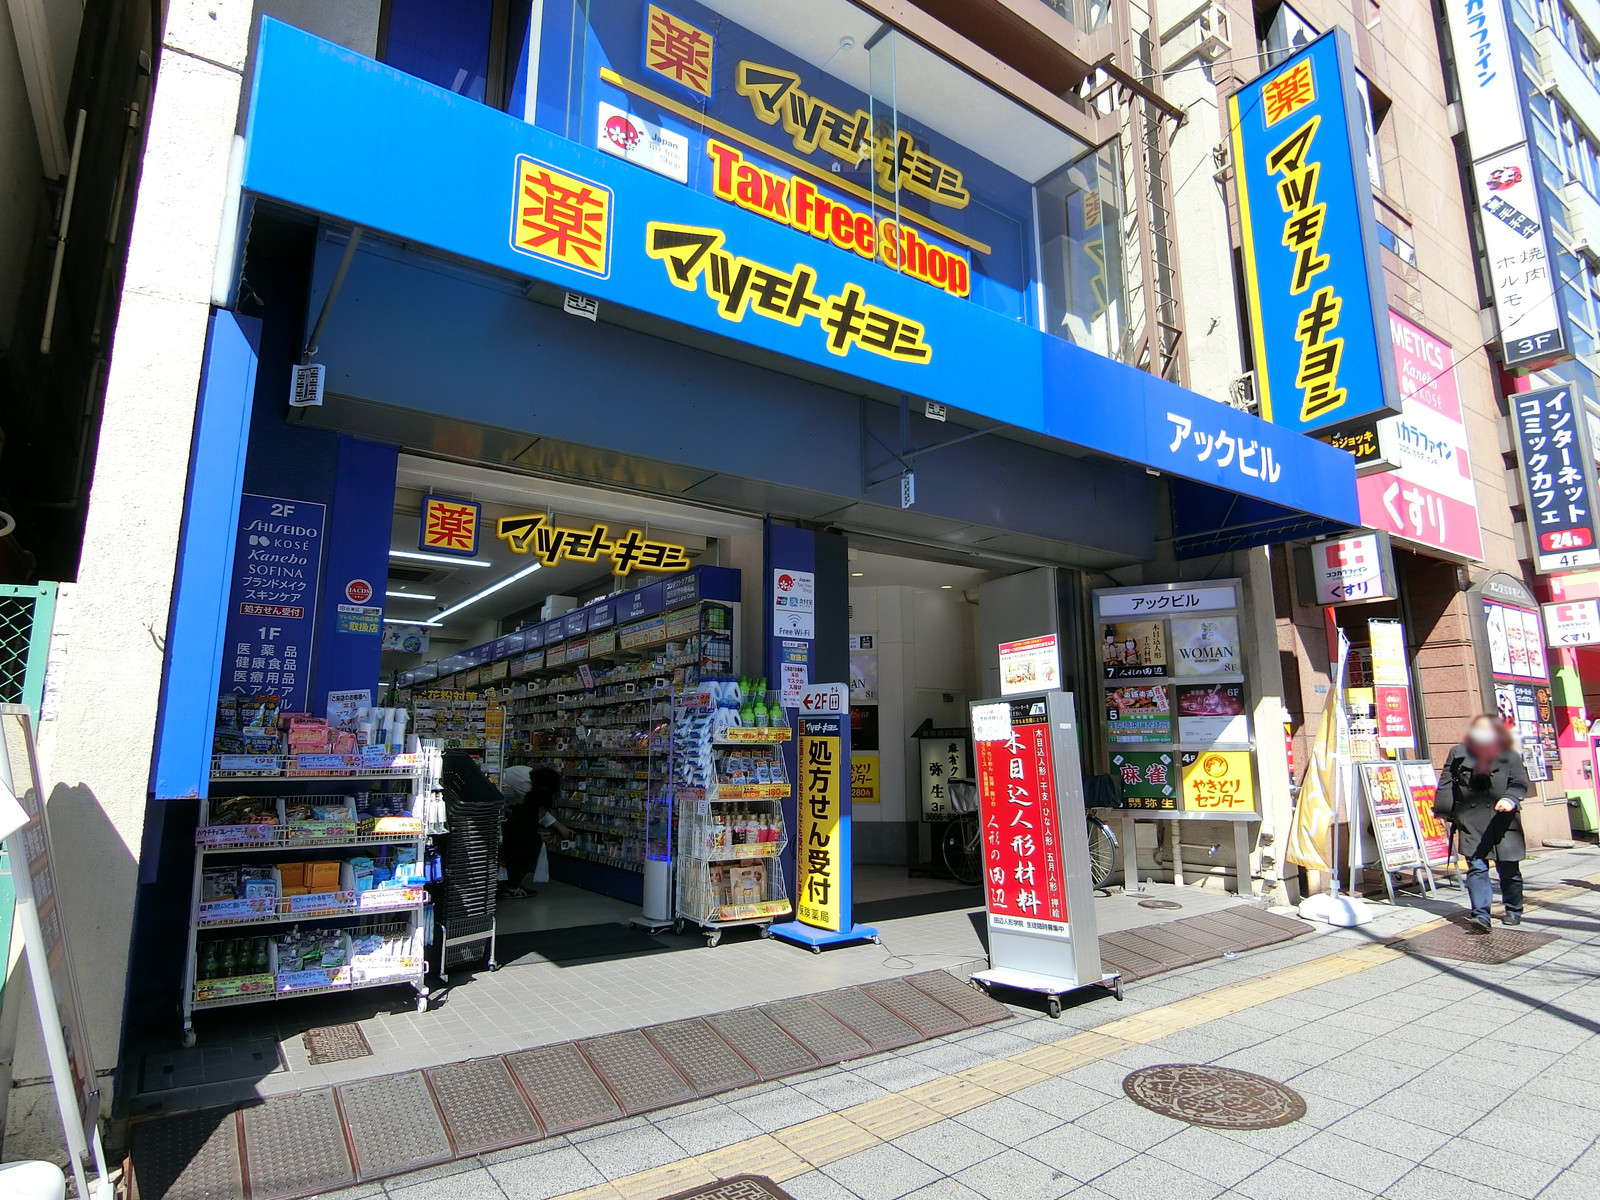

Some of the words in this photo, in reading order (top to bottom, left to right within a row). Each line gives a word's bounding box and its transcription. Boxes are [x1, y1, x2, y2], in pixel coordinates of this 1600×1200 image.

[650, 12, 711, 93] 薬
[1265, 62, 1312, 125] 薬
[651, 132, 679, 150] Japan
[740, 64, 969, 206] マツモトキヨシ
[522, 169, 602, 269] 薬
[710, 141, 789, 221] Tax
[793, 178, 876, 256] Free
[880, 219, 969, 294] Shop
[1268, 117, 1346, 420] マツモトキヨシ
[1521, 247, 1547, 285] 焼肉
[649, 225, 929, 362] マツモトキヨシ
[1496, 256, 1526, 328] ホルモン
[1518, 334, 1551, 354] 3F
[1402, 357, 1438, 390] Kanebo
[1166, 411, 1281, 483] アックビル
[1396, 420, 1452, 460] カラファイン
[1519, 399, 1561, 525] コミックカフェ
[1545, 391, 1586, 523] インターネット
[270, 503, 296, 517] 2F
[1382, 481, 1446, 544] くすり
[243, 519, 318, 538] SHISEIDO
[427, 502, 475, 550] 薬
[274, 538, 310, 551] KOSÉ
[499, 515, 689, 573] マツモトキヨシ
[247, 549, 308, 566] Kanebo
[1559, 555, 1580, 568] 4F
[248, 563, 304, 578] SOFINA
[1326, 566, 1369, 579] ココカラファイン
[242, 576, 307, 592] ブランドメイク
[1330, 581, 1369, 599] くすり
[245, 589, 302, 603] スキンケア
[1131, 594, 1200, 611] アックビル
[244, 604, 301, 617] 処方せん受付
[258, 627, 282, 640] 1F
[348, 621, 379, 633] 取扱店
[779, 627, 794, 636] Free
[794, 628, 811, 637] Wi-Fi
[1560, 632, 1591, 643] くすり
[237, 642, 298, 658] 医薬品
[1179, 646, 1235, 660] WOMAN
[235, 656, 297, 671] 健康食品
[233, 670, 296, 685] 医療用品
[1106, 668, 1115, 678] 7
[232, 685, 294, 697] ヘアケア
[427, 689, 479, 701] 花粉対策
[1226, 688, 1240, 697] 6F
[814, 692, 828, 710] 2F
[1109, 709, 1118, 720] 5
[948, 742, 960, 779] 麻雀ク
[1182, 751, 1196, 762] 4F
[929, 762, 945, 799] 弥生
[1120, 763, 1168, 785] 麻雀
[1192, 779, 1241, 794] やきとり
[931, 802, 945, 812] 3F
[1144, 797, 1175, 809] 弥生
[1194, 794, 1245, 808] センター
[326, 826, 345, 836] 82
[807, 740, 832, 905] 処方せん受付
[1003, 730, 1042, 916] 木目込人形材料
[987, 814, 1008, 908] 人形の田辺
[240, 982, 261, 992] 63
